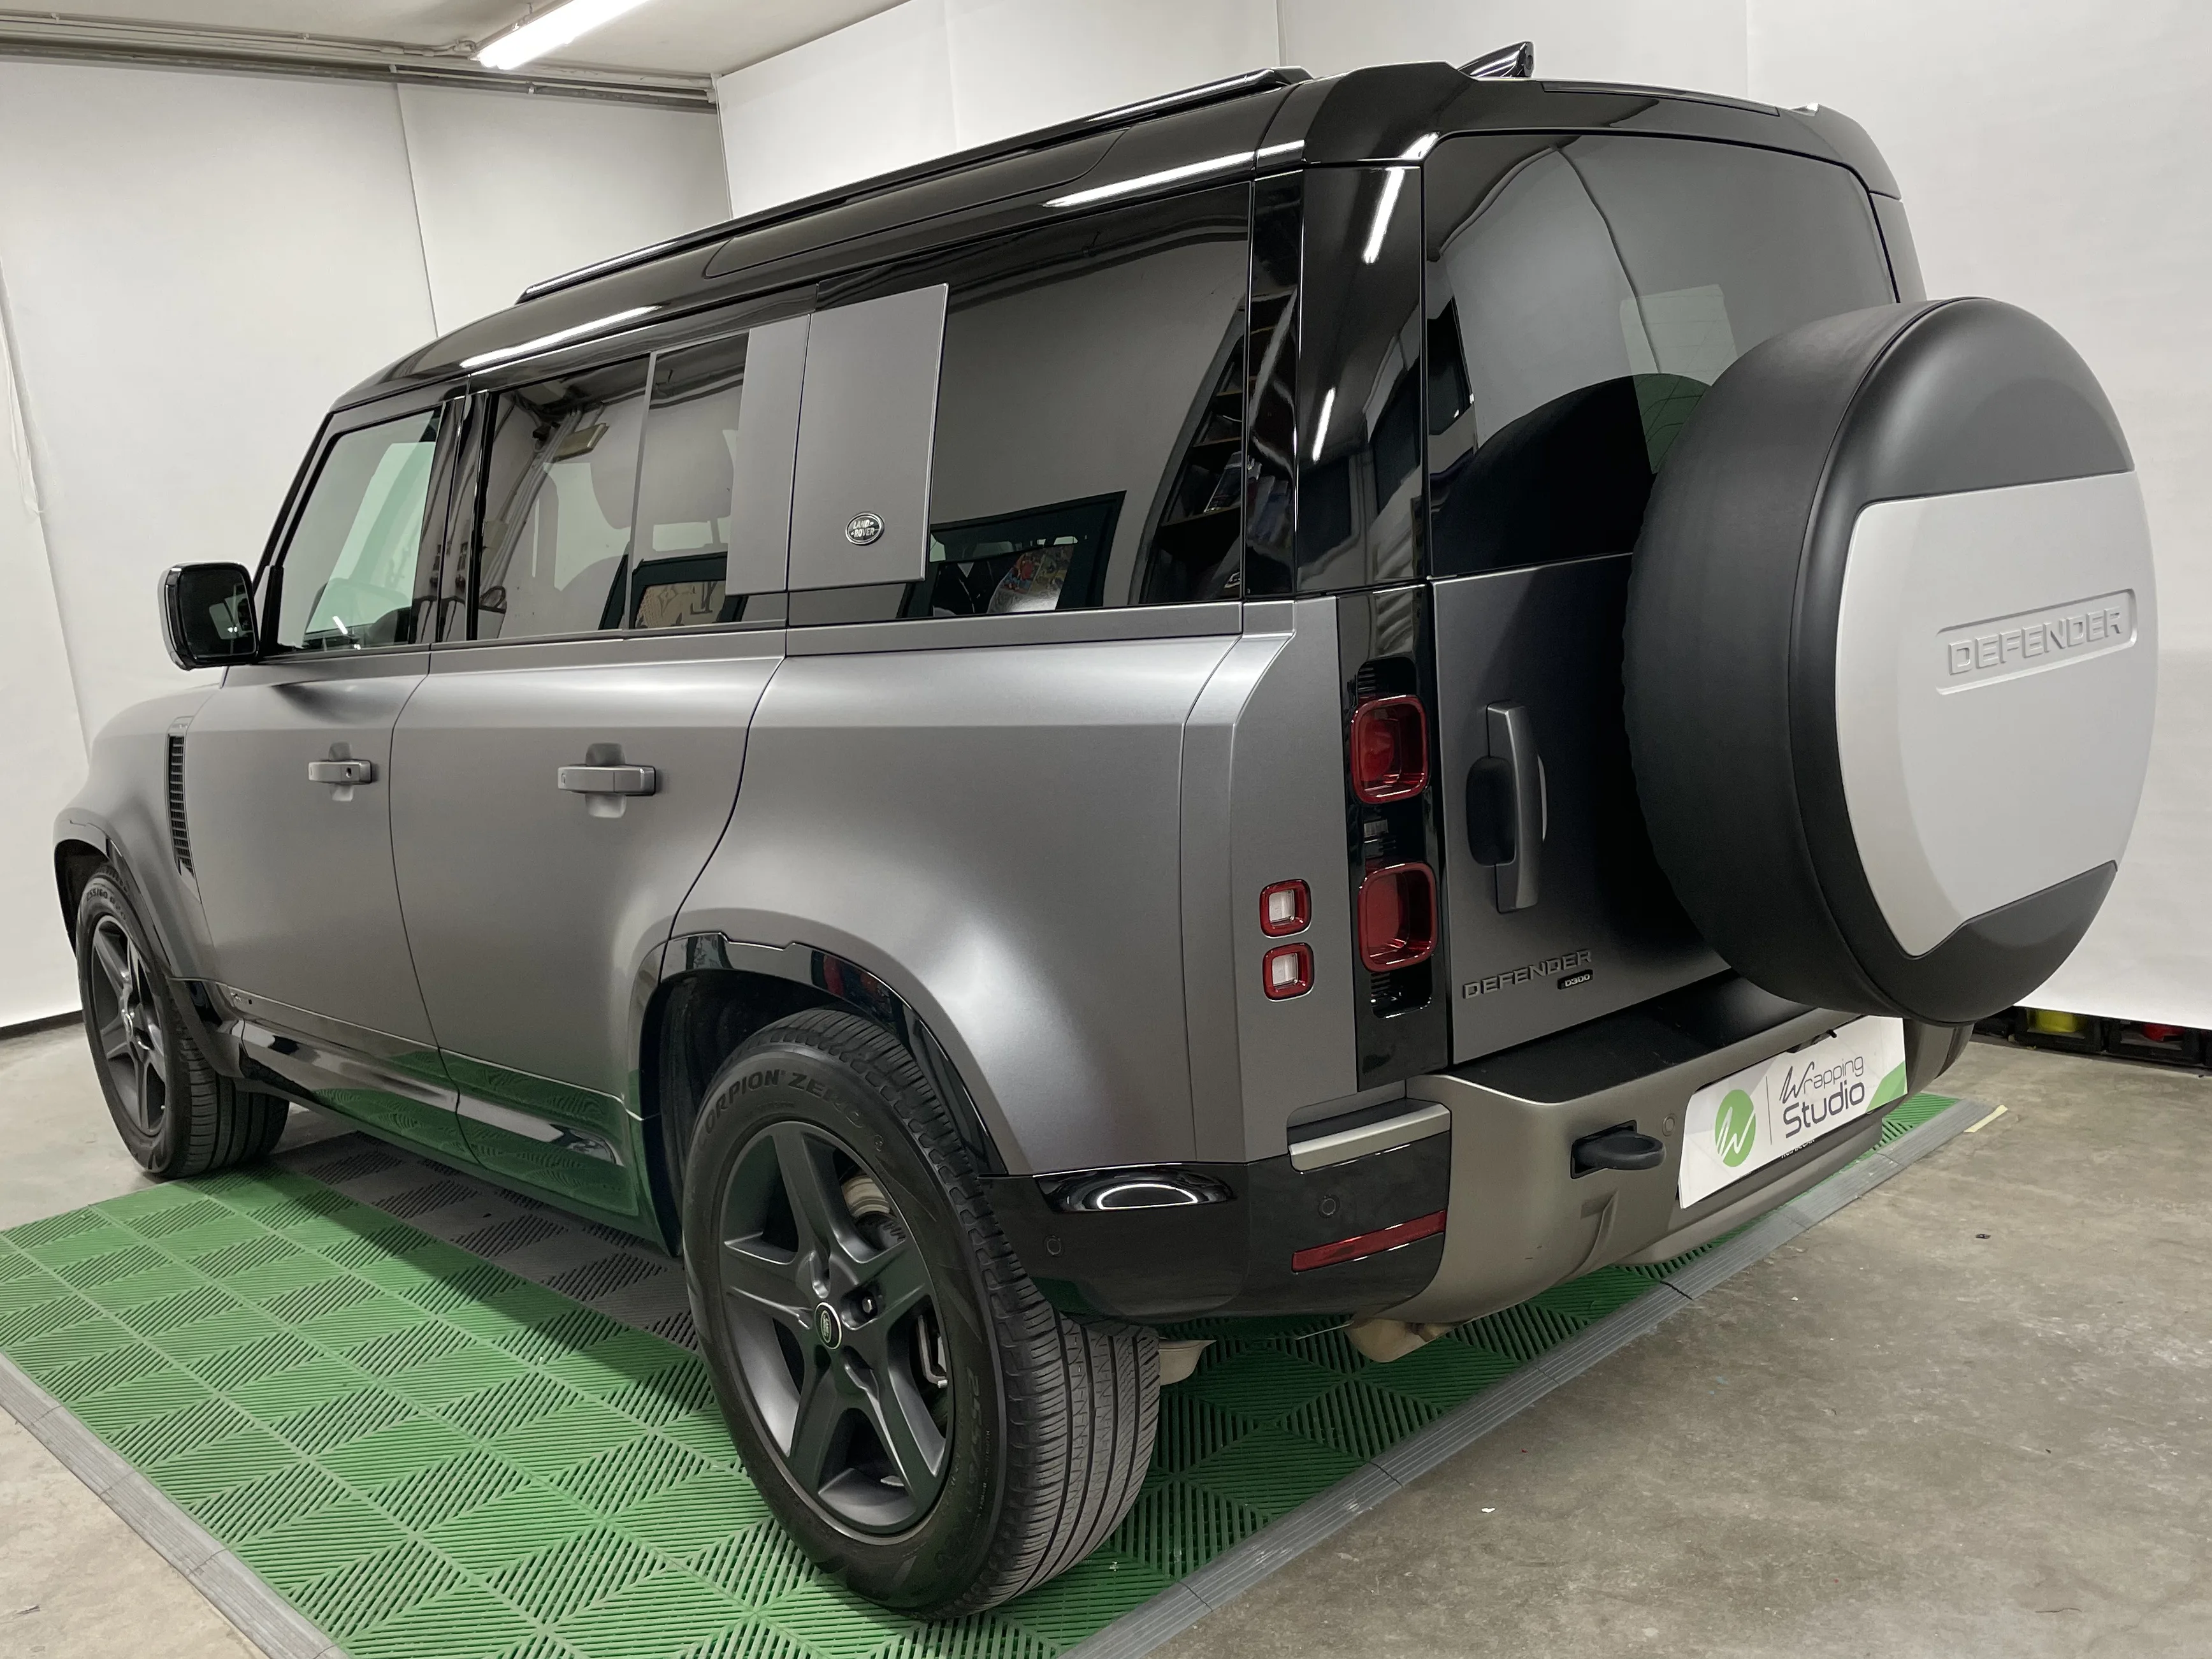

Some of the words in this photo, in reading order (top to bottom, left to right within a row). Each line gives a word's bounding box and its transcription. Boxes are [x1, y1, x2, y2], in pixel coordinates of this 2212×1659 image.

[853, 519, 870, 529] LAND
[854, 528, 875, 537] ROVER
[1948, 606, 2122, 676] DEFENDER
[1463, 949, 1592, 999] DEFENDER
[1565, 973, 1591, 987] D300
[1779, 1056, 1864, 1104] Wrapping
[1783, 1080, 1865, 1139] Studio
